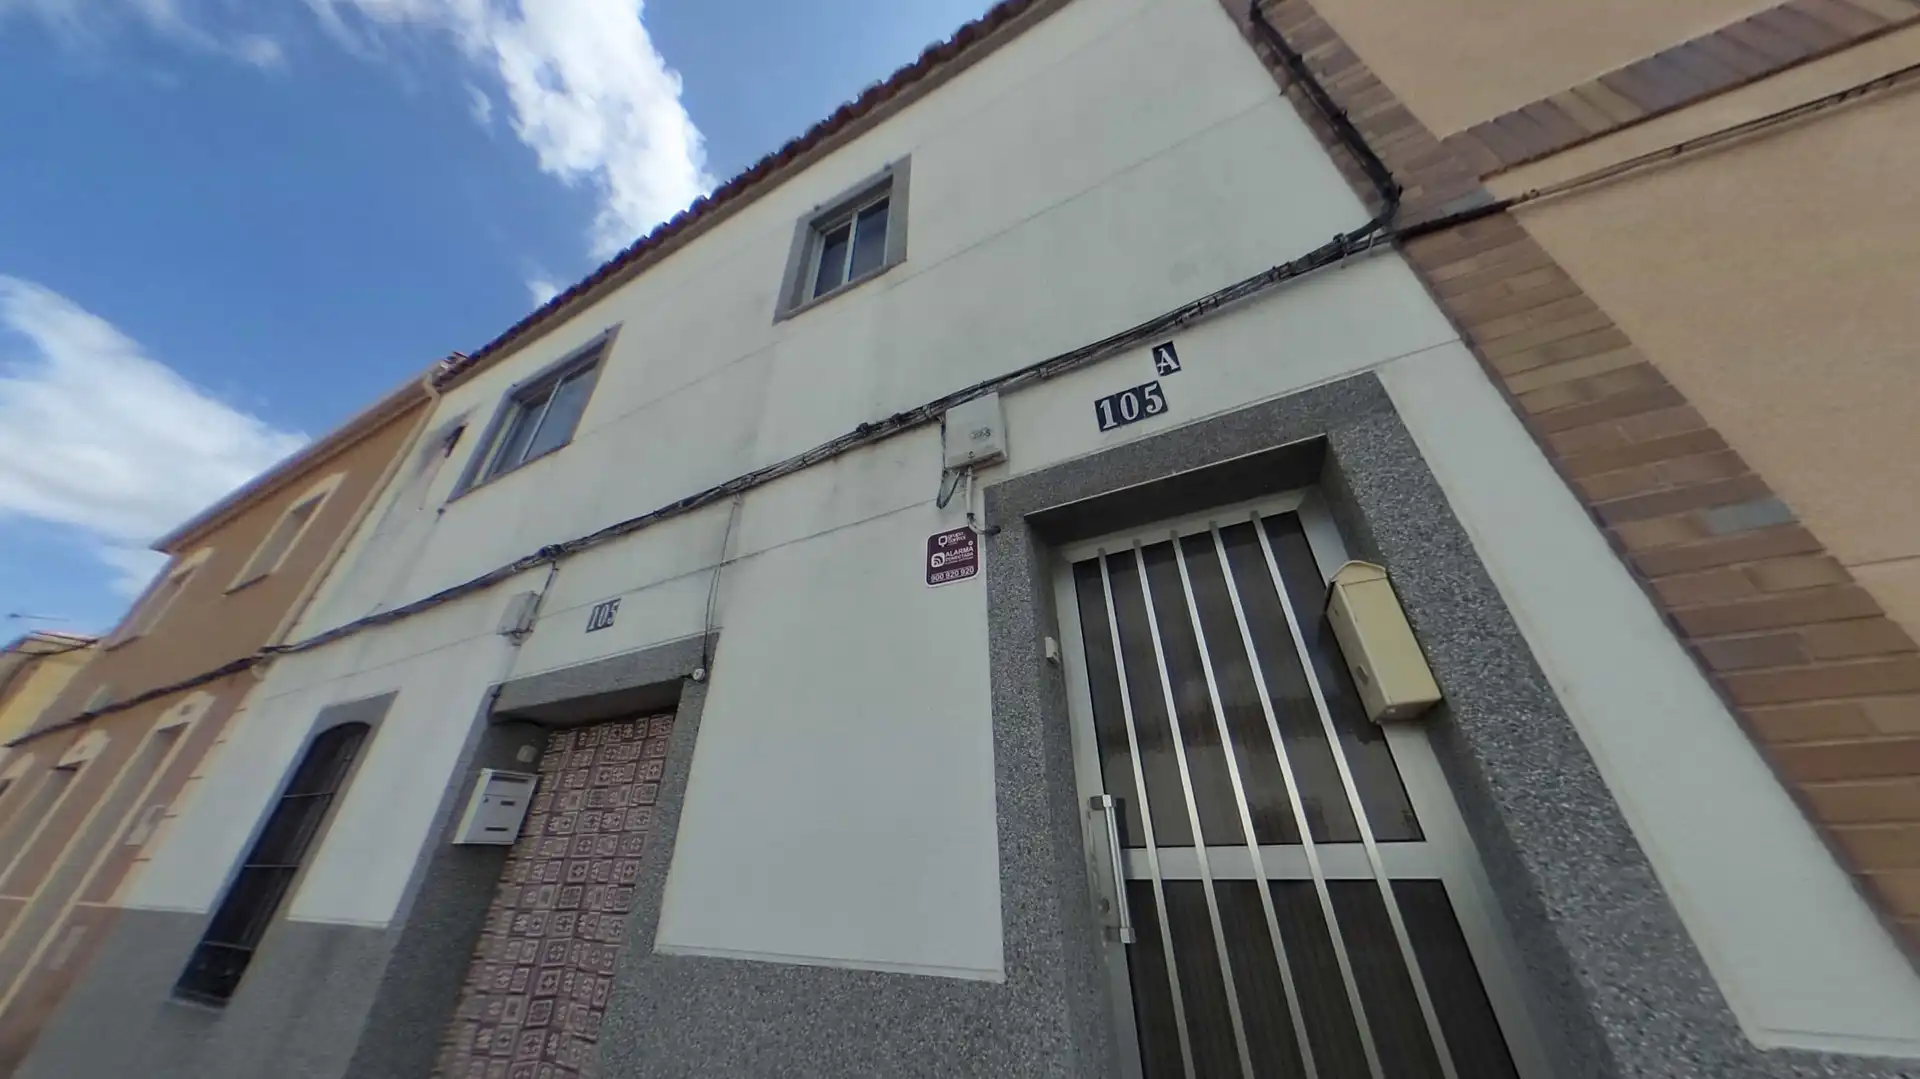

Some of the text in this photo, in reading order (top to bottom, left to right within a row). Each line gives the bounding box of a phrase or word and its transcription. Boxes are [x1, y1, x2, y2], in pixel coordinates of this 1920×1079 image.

[1156, 347, 1180, 374] A
[1099, 382, 1163, 430] 105
[945, 546, 974, 557] ALARMA
[930, 566, 975, 583] 900 920 920
[589, 601, 620, 630] 105
